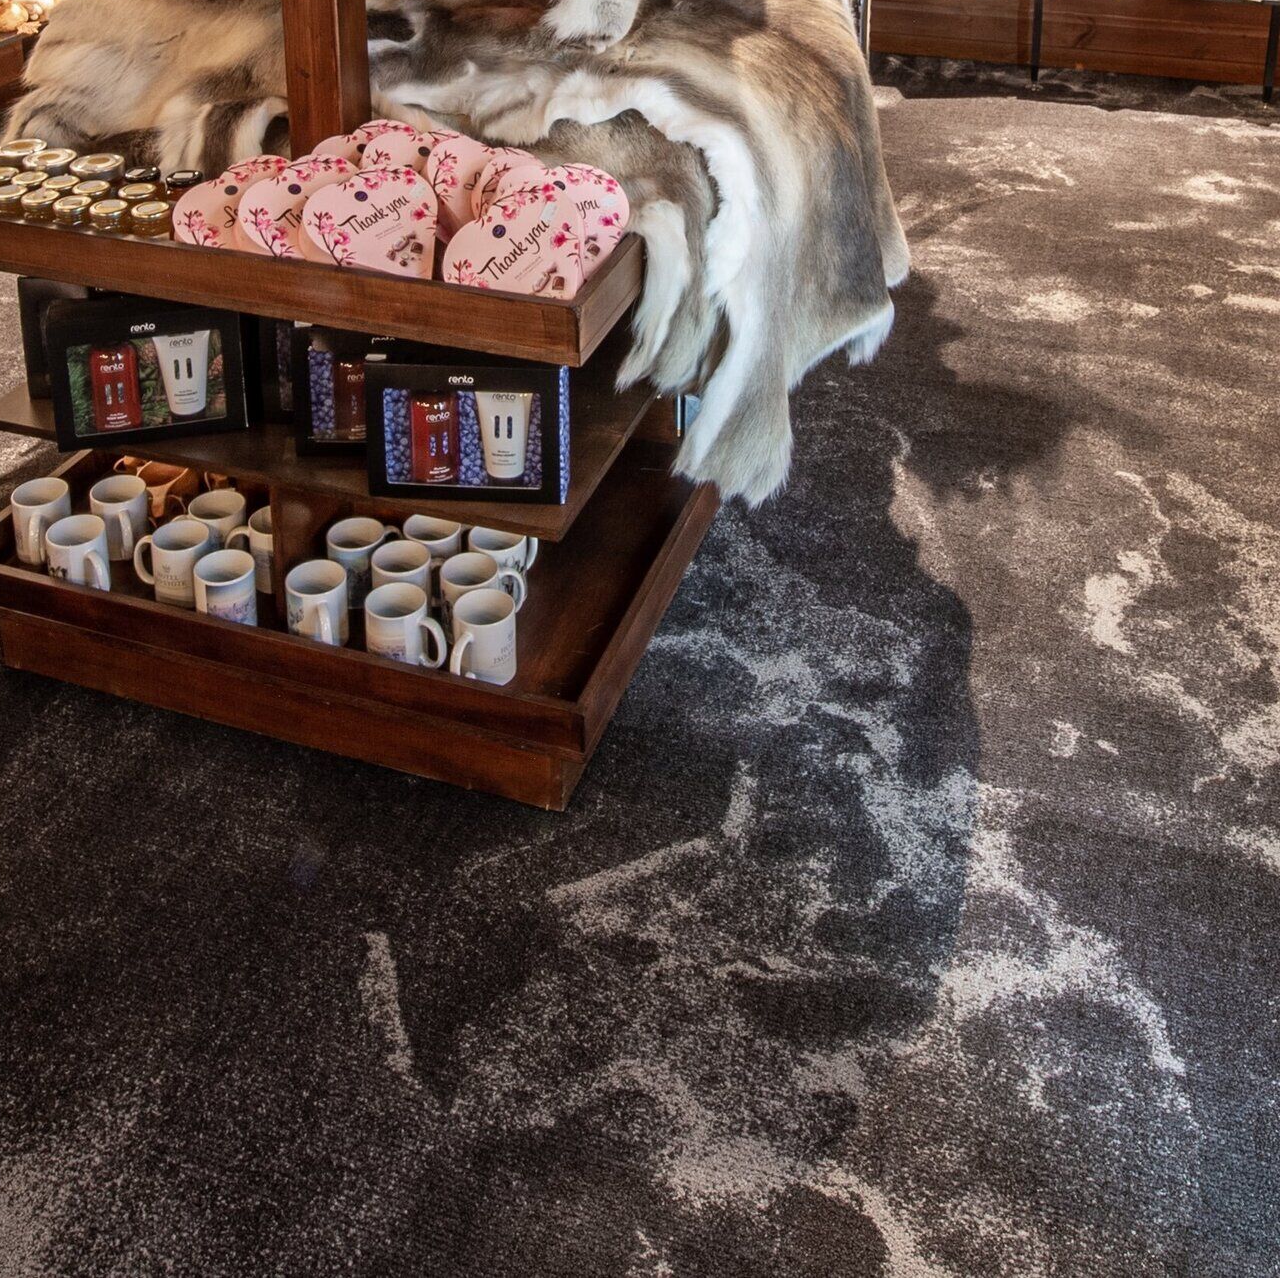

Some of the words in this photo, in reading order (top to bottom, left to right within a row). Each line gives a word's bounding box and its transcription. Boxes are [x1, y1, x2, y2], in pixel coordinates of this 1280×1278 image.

[337, 203, 389, 235] Thank
[385, 195, 411, 222] you
[576, 199, 600, 220] you
[477, 237, 528, 281] Thank
[524, 220, 551, 255] you
[130, 322, 156, 333] rento
[169, 337, 194, 348] rento
[100, 362, 125, 373] rento
[448, 375, 474, 385] rento
[492, 393, 517, 403] rento
[426, 411, 451, 423] rento
